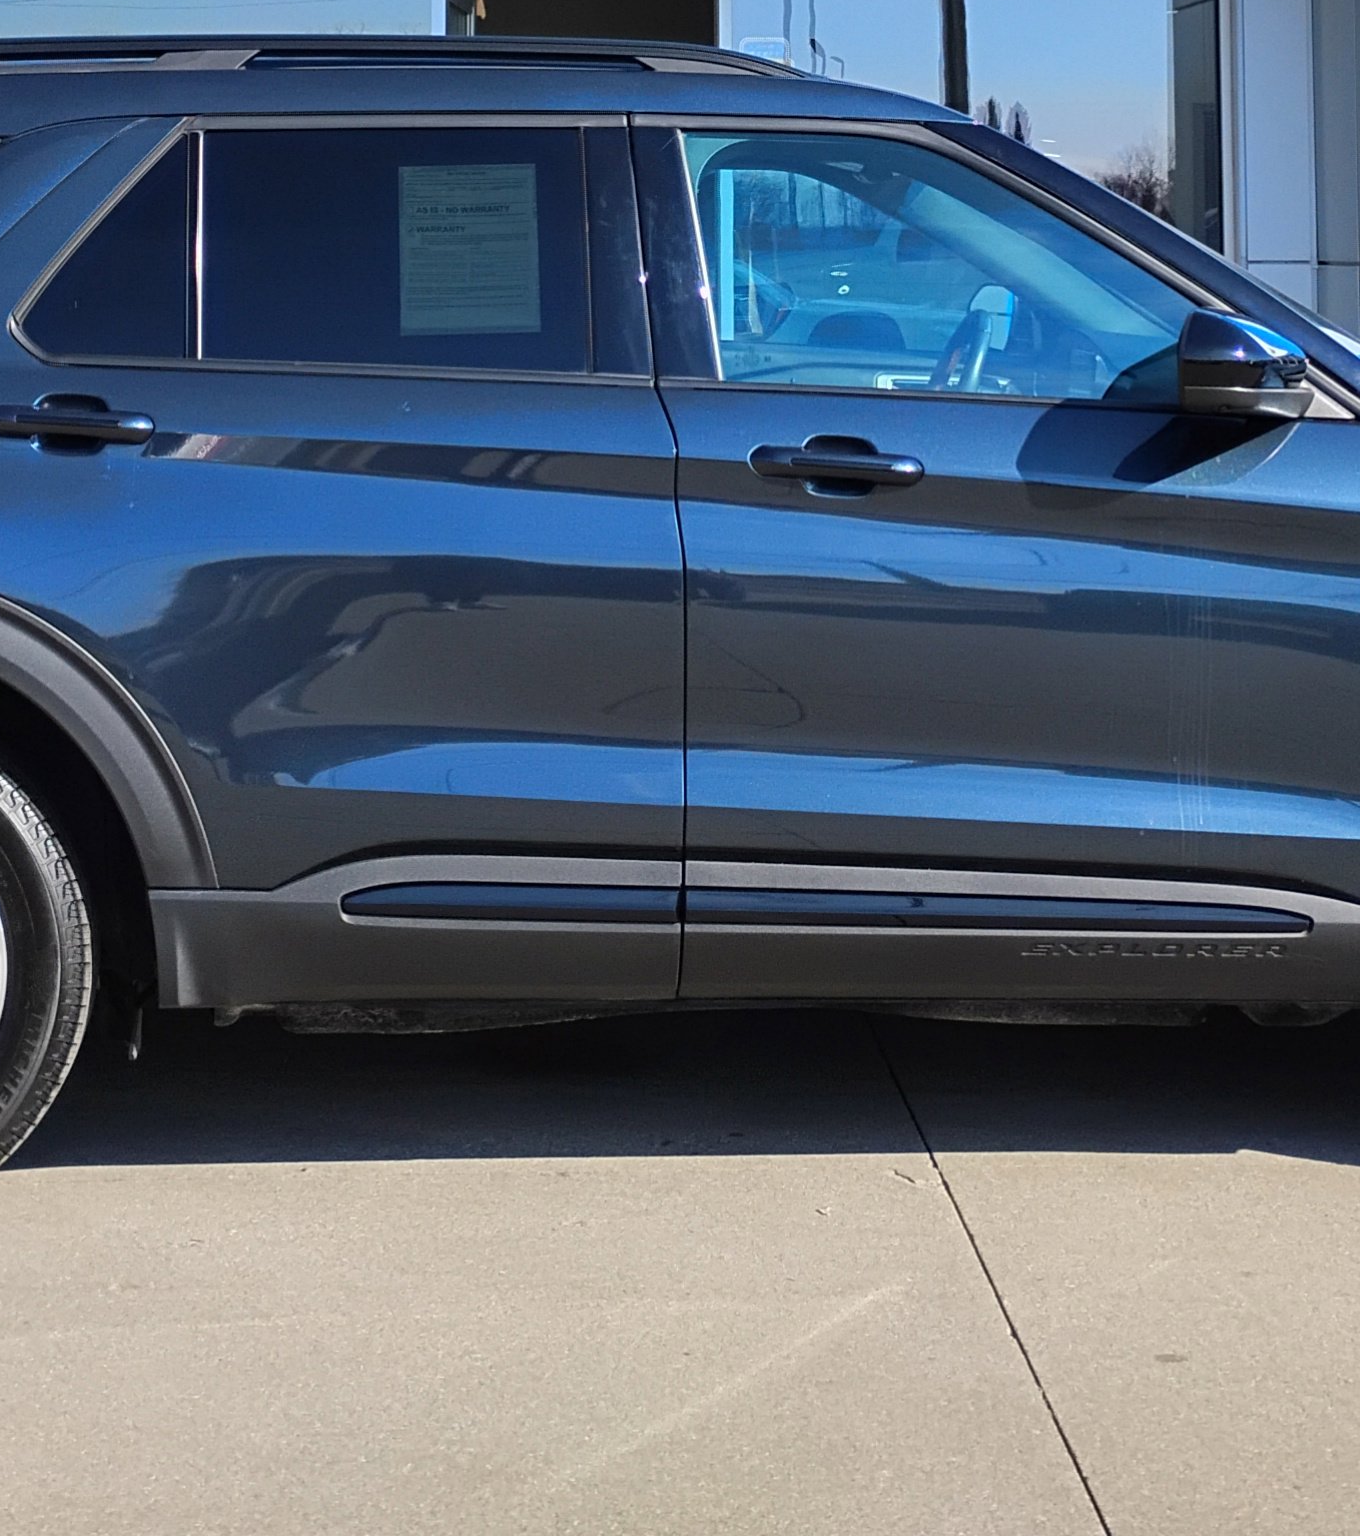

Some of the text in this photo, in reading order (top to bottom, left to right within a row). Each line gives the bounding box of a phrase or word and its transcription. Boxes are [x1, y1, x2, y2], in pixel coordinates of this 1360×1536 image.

[416, 206, 428, 214] AS
[446, 206, 459, 214] NO
[460, 204, 510, 213] WARRANTY
[416, 225, 466, 233] WARRANTY
[1021, 942, 1288, 958] EXPLORER
